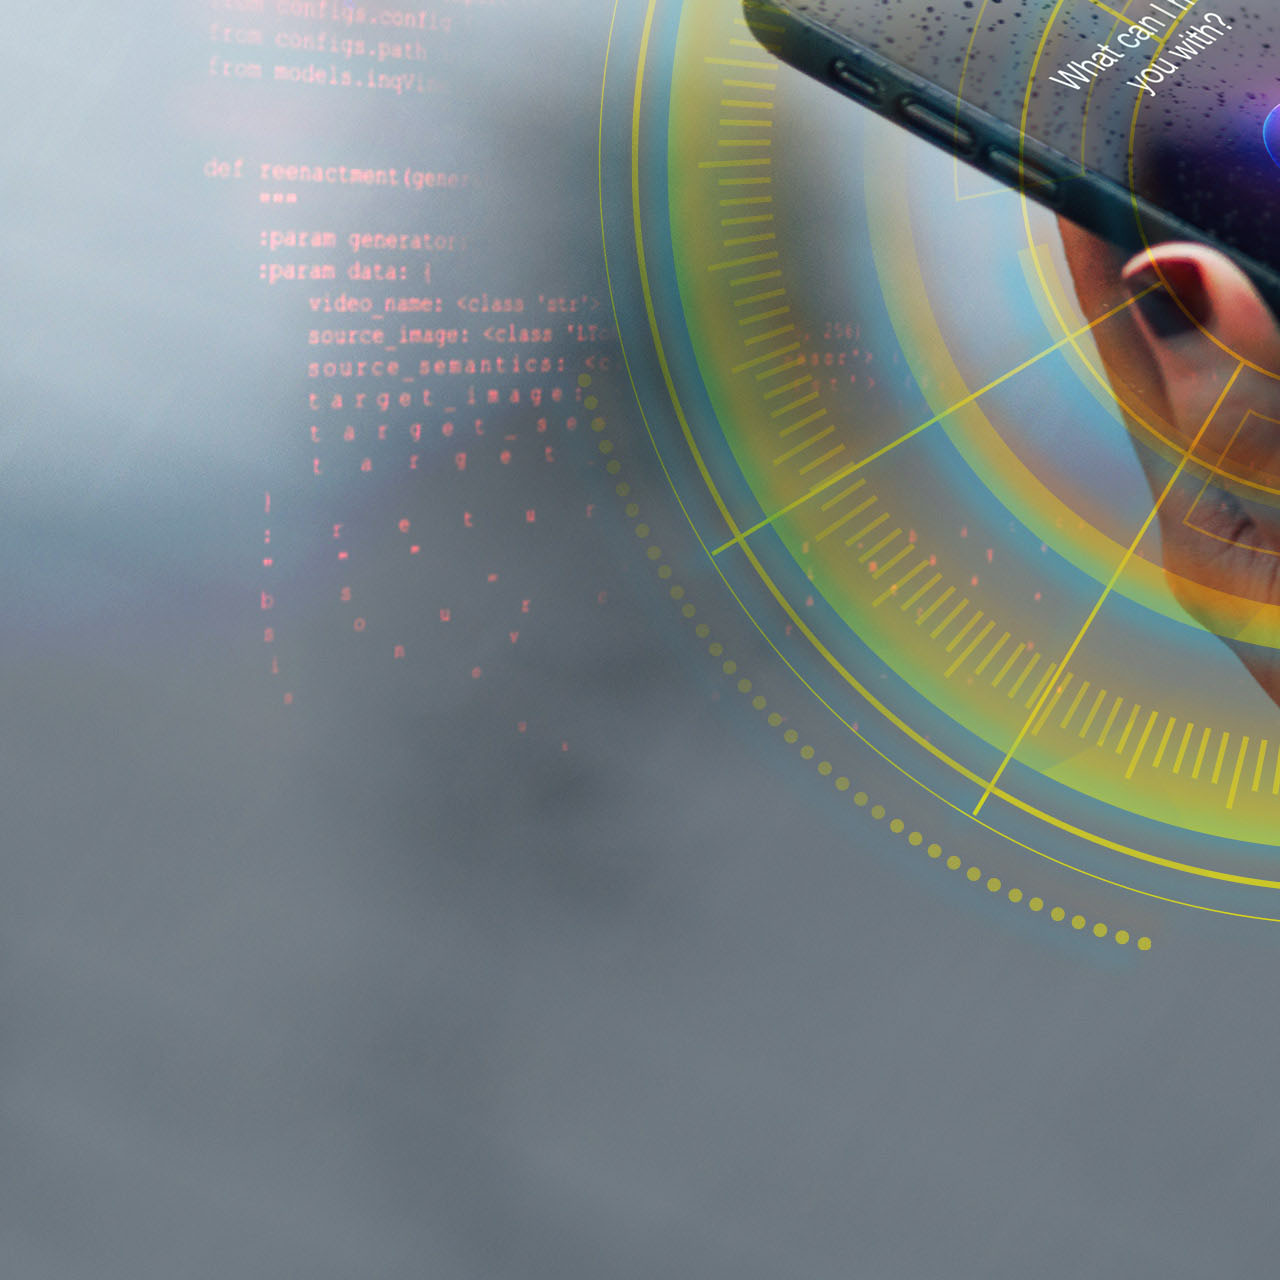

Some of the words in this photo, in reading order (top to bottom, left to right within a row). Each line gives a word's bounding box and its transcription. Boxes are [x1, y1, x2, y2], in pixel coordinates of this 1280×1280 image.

[1049, 43, 1126, 90] What
[1117, 15, 1167, 49] can
[1149, 3, 1177, 19] I
[1126, 57, 1180, 97] you
[1168, 12, 1233, 61] with?
